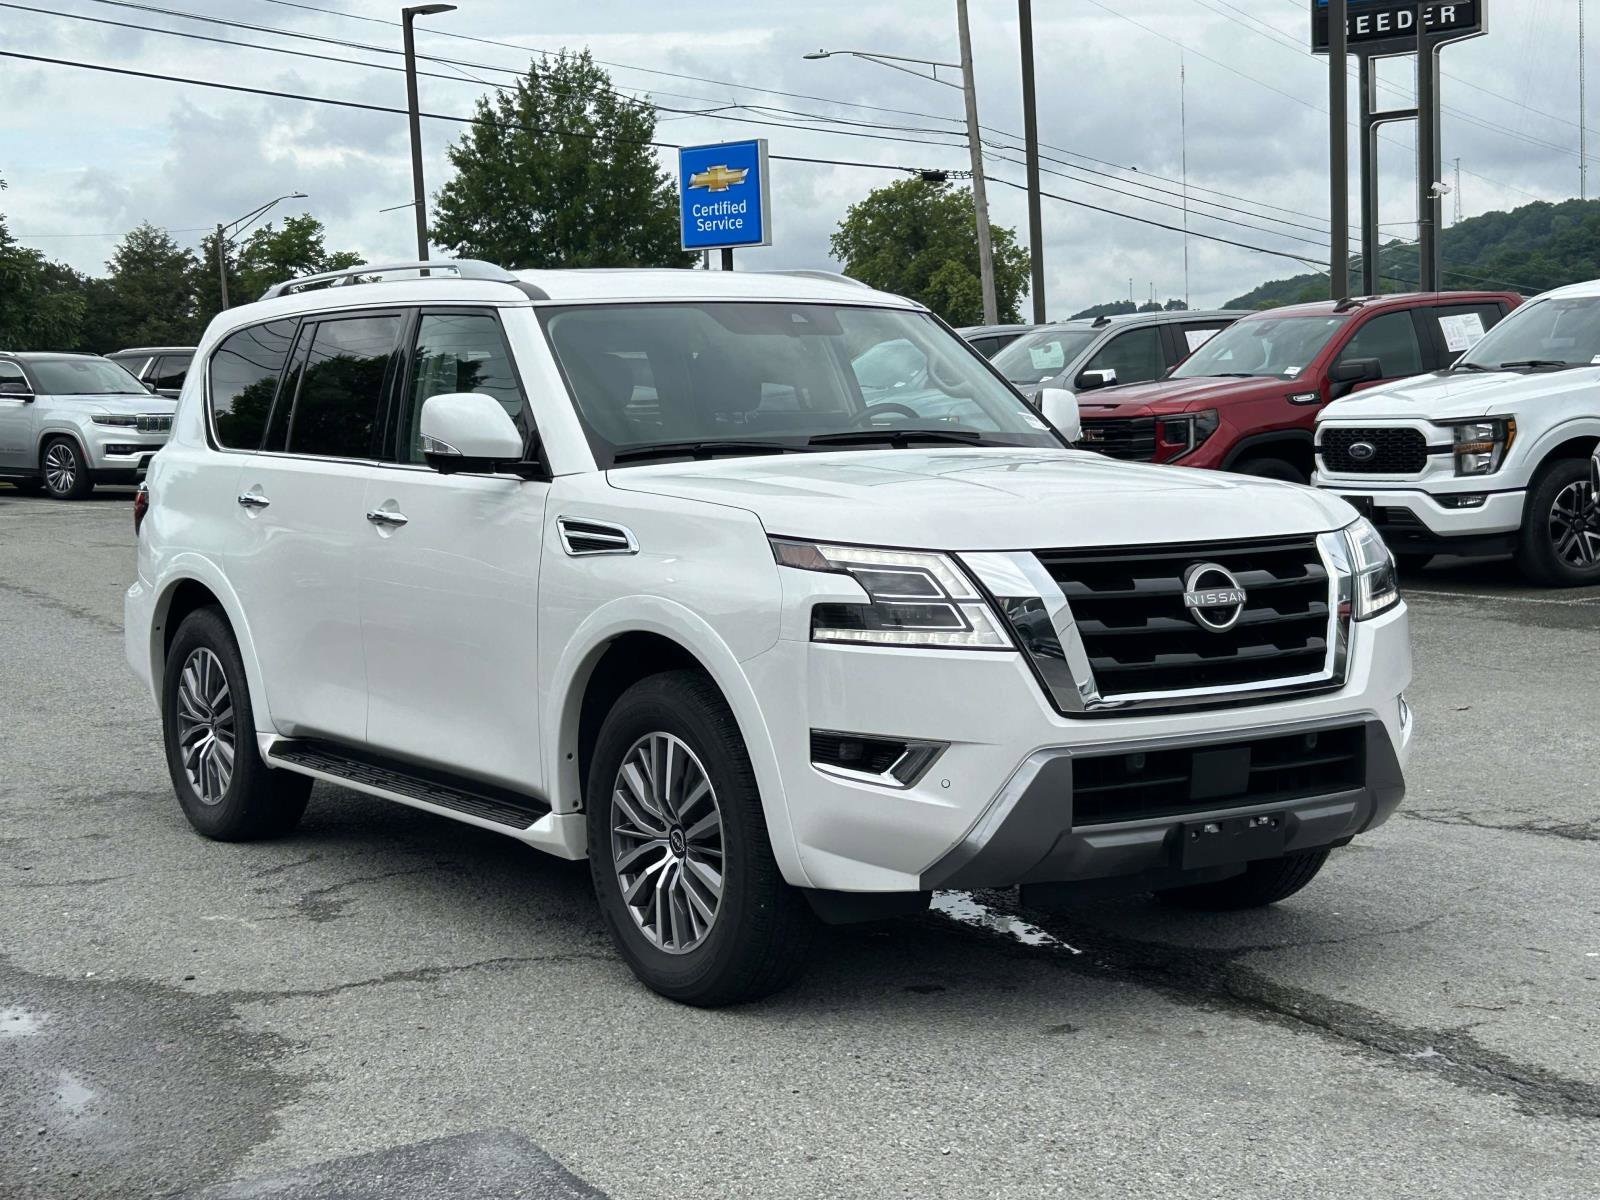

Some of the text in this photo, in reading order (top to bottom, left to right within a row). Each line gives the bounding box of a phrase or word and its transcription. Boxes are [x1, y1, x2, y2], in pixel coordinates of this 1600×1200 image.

[1345, 5, 1456, 36] EEDER
[692, 199, 747, 217] Certified
[697, 216, 743, 231] Service
[1186, 591, 1246, 605] NISSAN
